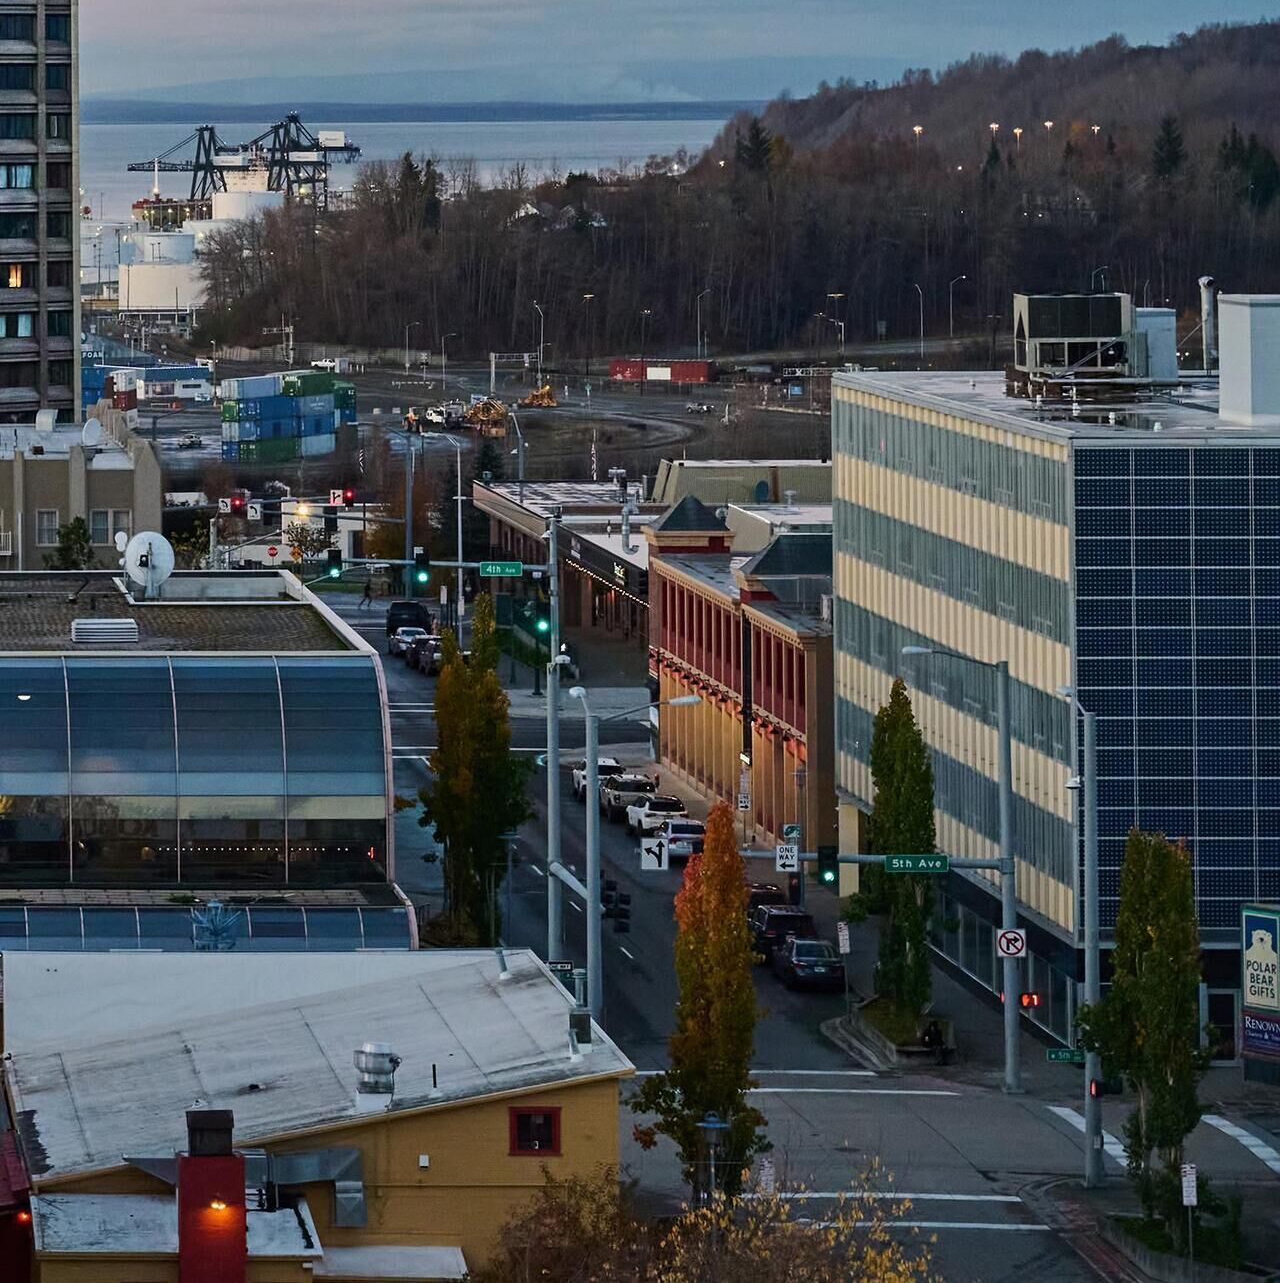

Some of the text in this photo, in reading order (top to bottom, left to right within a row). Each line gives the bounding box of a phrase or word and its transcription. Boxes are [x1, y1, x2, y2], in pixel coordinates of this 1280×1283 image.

[486, 564, 501, 574] 4th
[779, 846, 795, 854] ONE
[778, 853, 795, 861] WAY
[892, 858, 942, 868] 5th Ave
[1246, 960, 1277, 975] POLAR
[1250, 973, 1274, 987] BEAR
[1250, 985, 1276, 999] GIFTS
